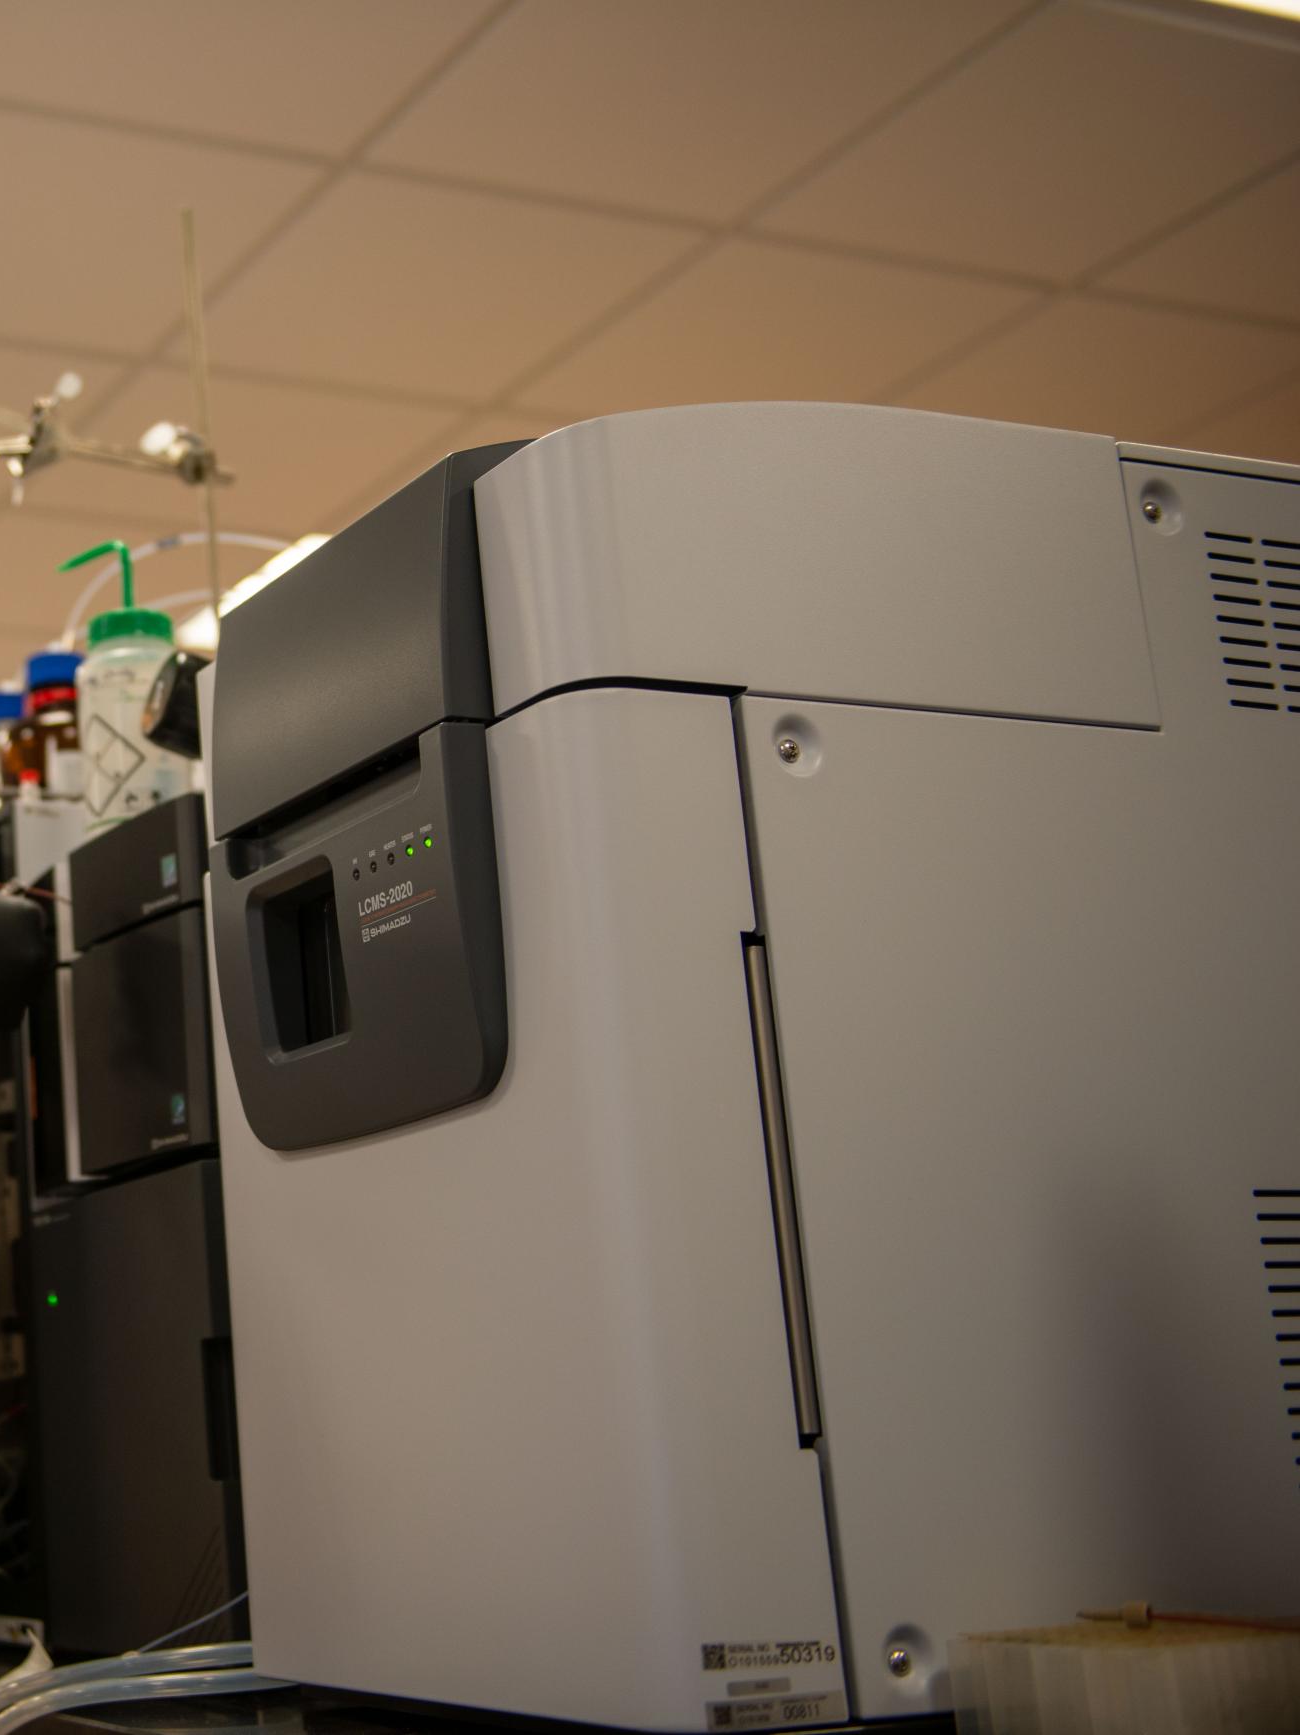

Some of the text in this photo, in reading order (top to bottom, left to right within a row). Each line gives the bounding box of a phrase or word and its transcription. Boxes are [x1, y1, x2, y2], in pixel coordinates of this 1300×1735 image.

[358, 880, 413, 916] LCMS-2020
[370, 913, 412, 937] SHIMADZU
[779, 1645, 835, 1664] 50319
